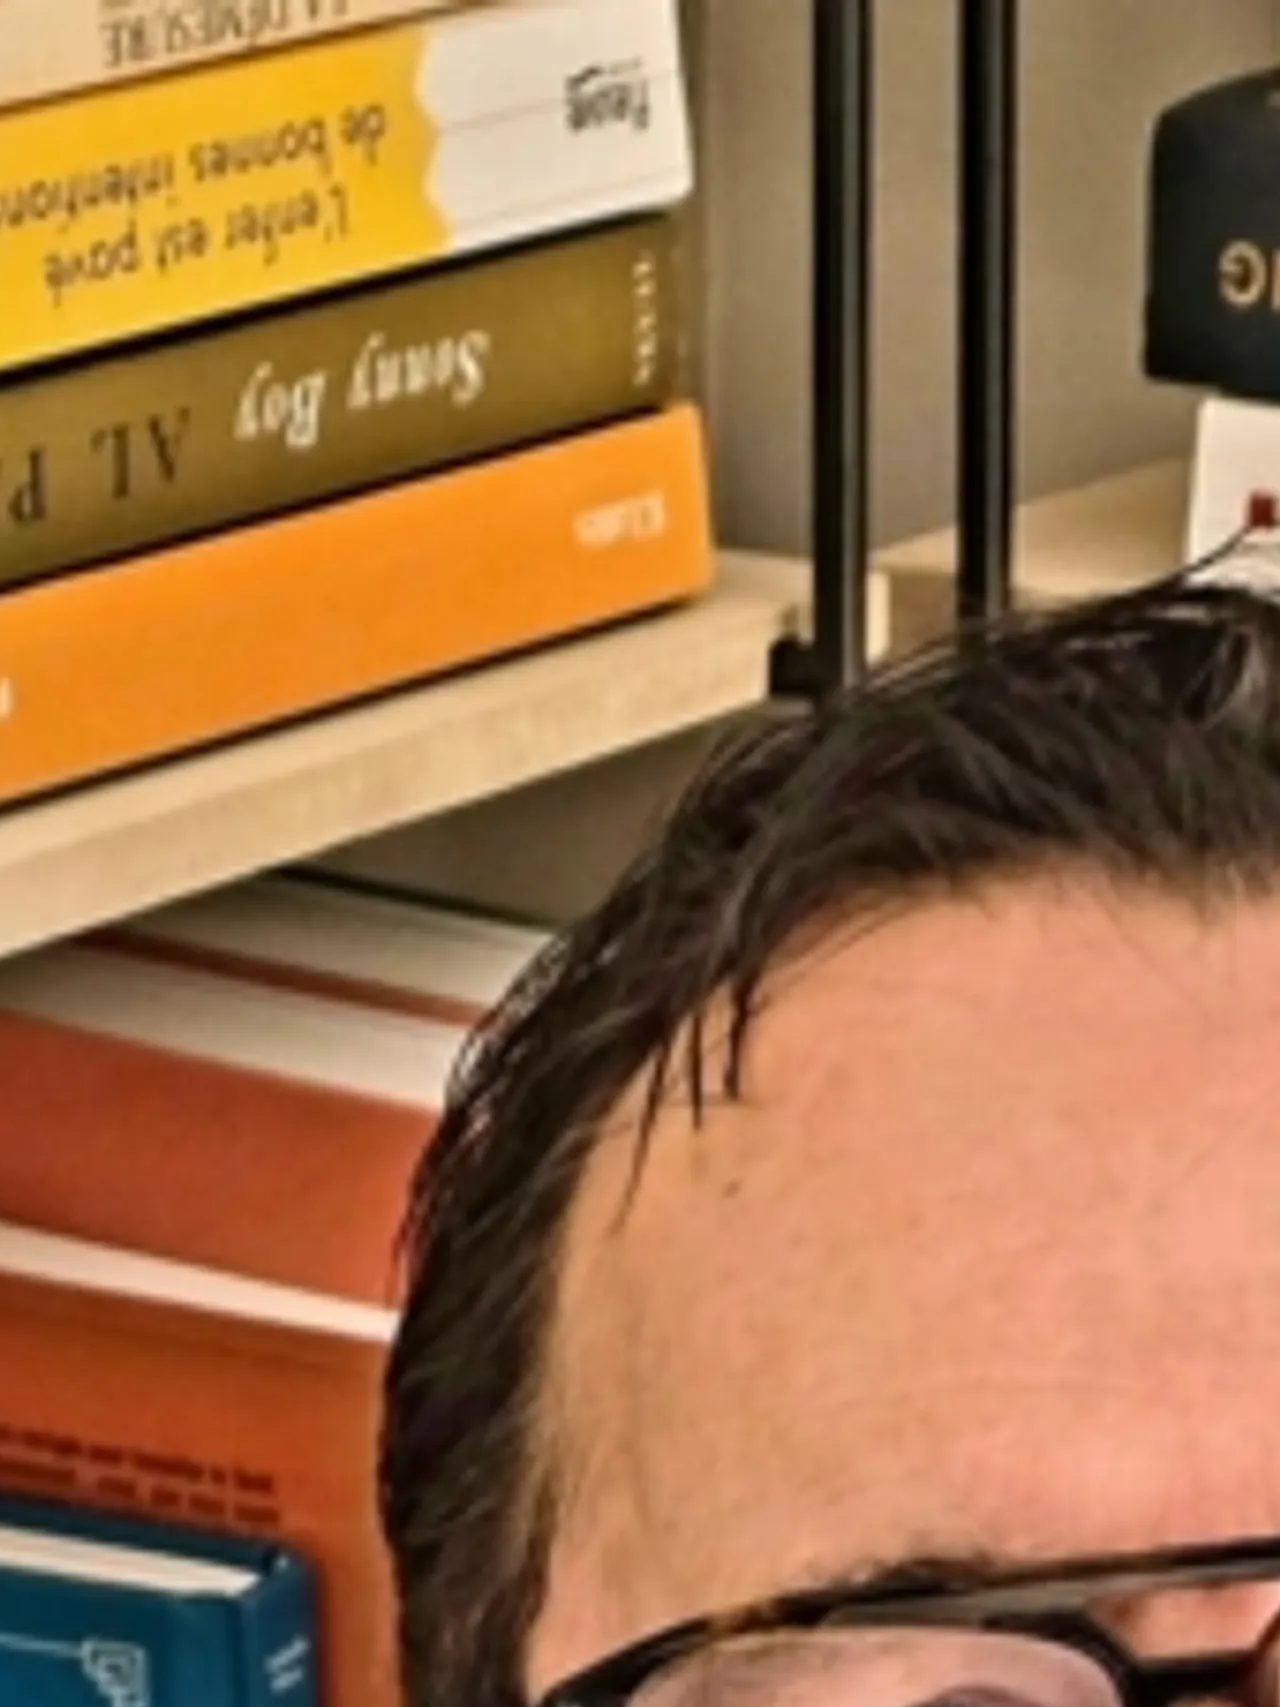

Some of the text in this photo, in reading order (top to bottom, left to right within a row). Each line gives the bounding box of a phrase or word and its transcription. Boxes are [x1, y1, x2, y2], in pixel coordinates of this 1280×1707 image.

[189, 119, 334, 177] bonnes
[343, 104, 389, 166] de
[42, 186, 351, 308] L'enfer est pavé
[233, 330, 493, 450] Sonny Boy
[92, 408, 192, 499] AL
